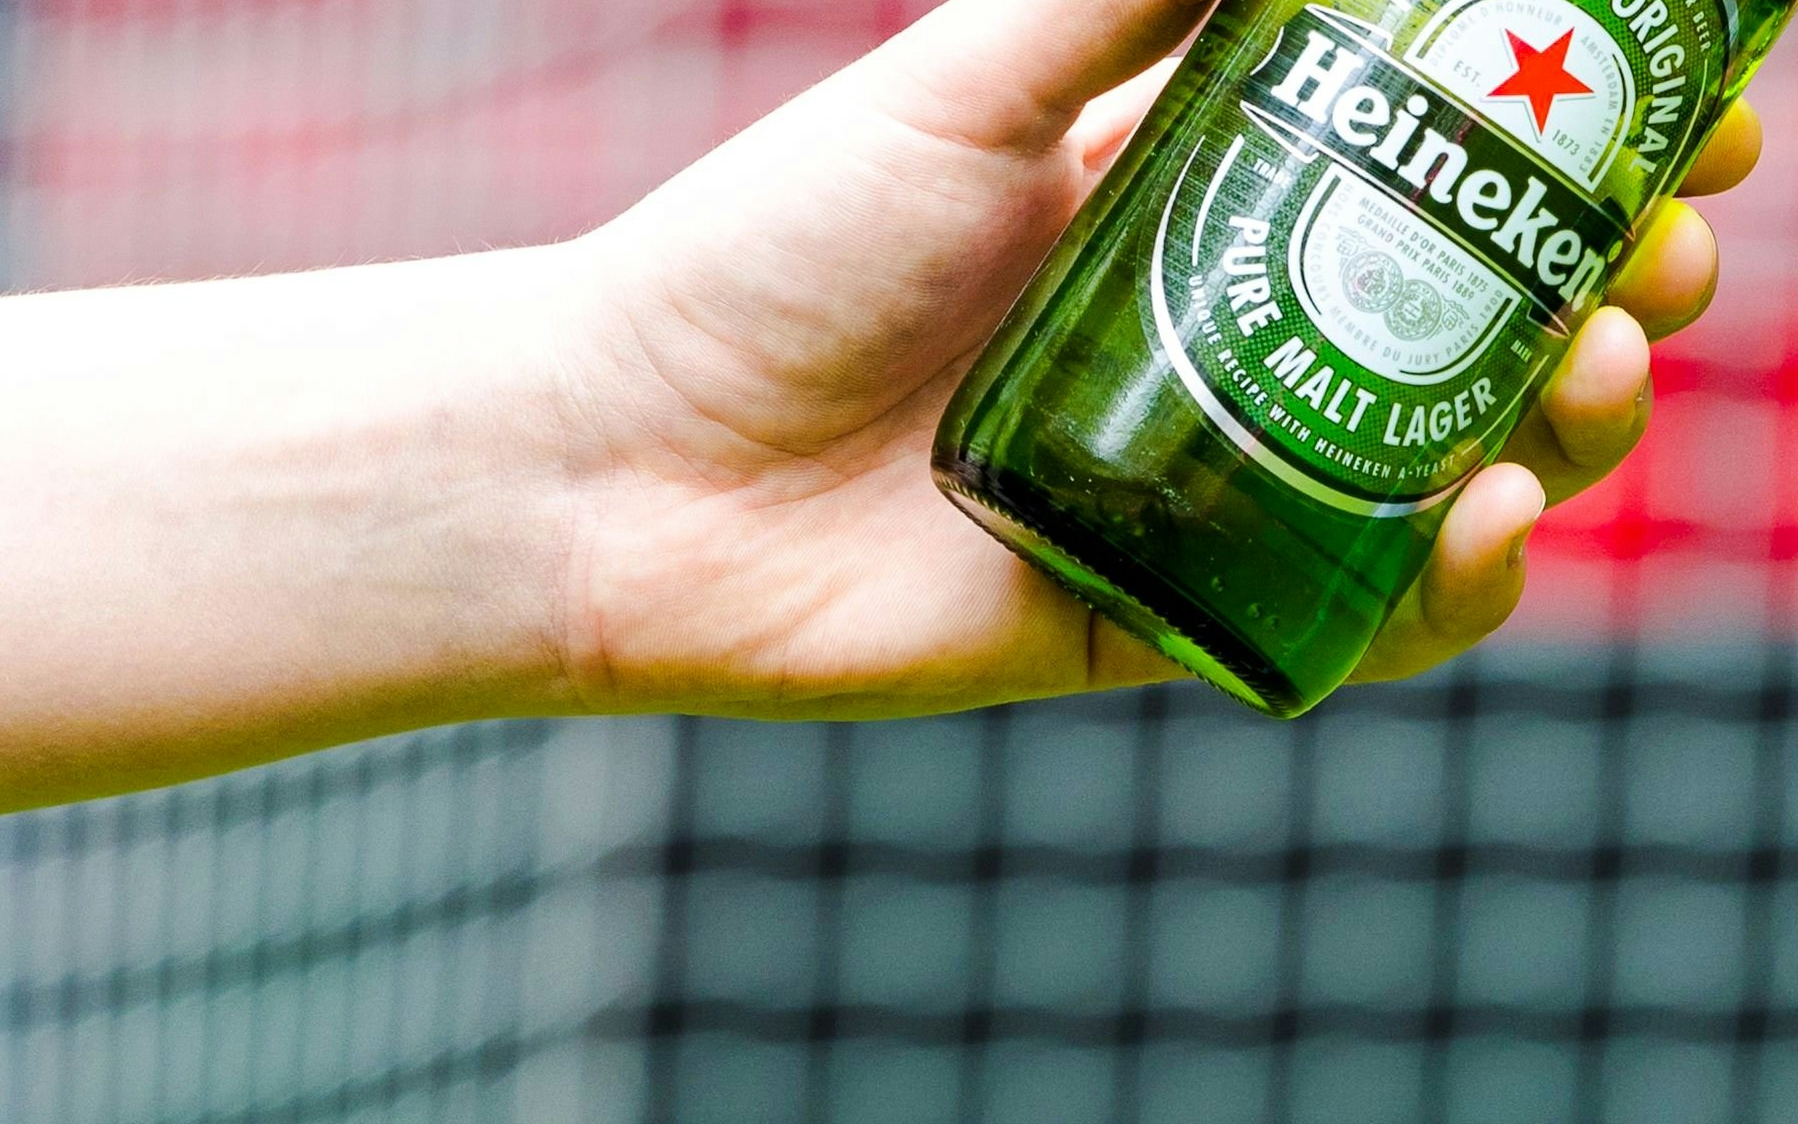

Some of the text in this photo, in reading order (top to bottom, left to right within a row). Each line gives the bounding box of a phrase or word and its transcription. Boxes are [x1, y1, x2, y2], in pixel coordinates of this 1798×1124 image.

[1581, 36, 1618, 110] AMSTERDAM
[1693, 11, 1712, 52] BEER
[1453, 60, 1581, 156] EST. 1873
[1357, 214, 1475, 301] GRAND PRIX PARIS 1889
[1359, 197, 1489, 293] MEDAILLE D'OR PARIS 1875
[1223, 216, 1497, 447] PURE MALT LAGER
[1383, 347, 1401, 362] DU
[1407, 353, 1440, 367] JURY
[1446, 325, 1479, 357] PARIS
[1480, 290, 1504, 320] 1900
[1188, 275, 1454, 480] UNIQUE RECIPE WITH HEINEKEN A-YEAST
